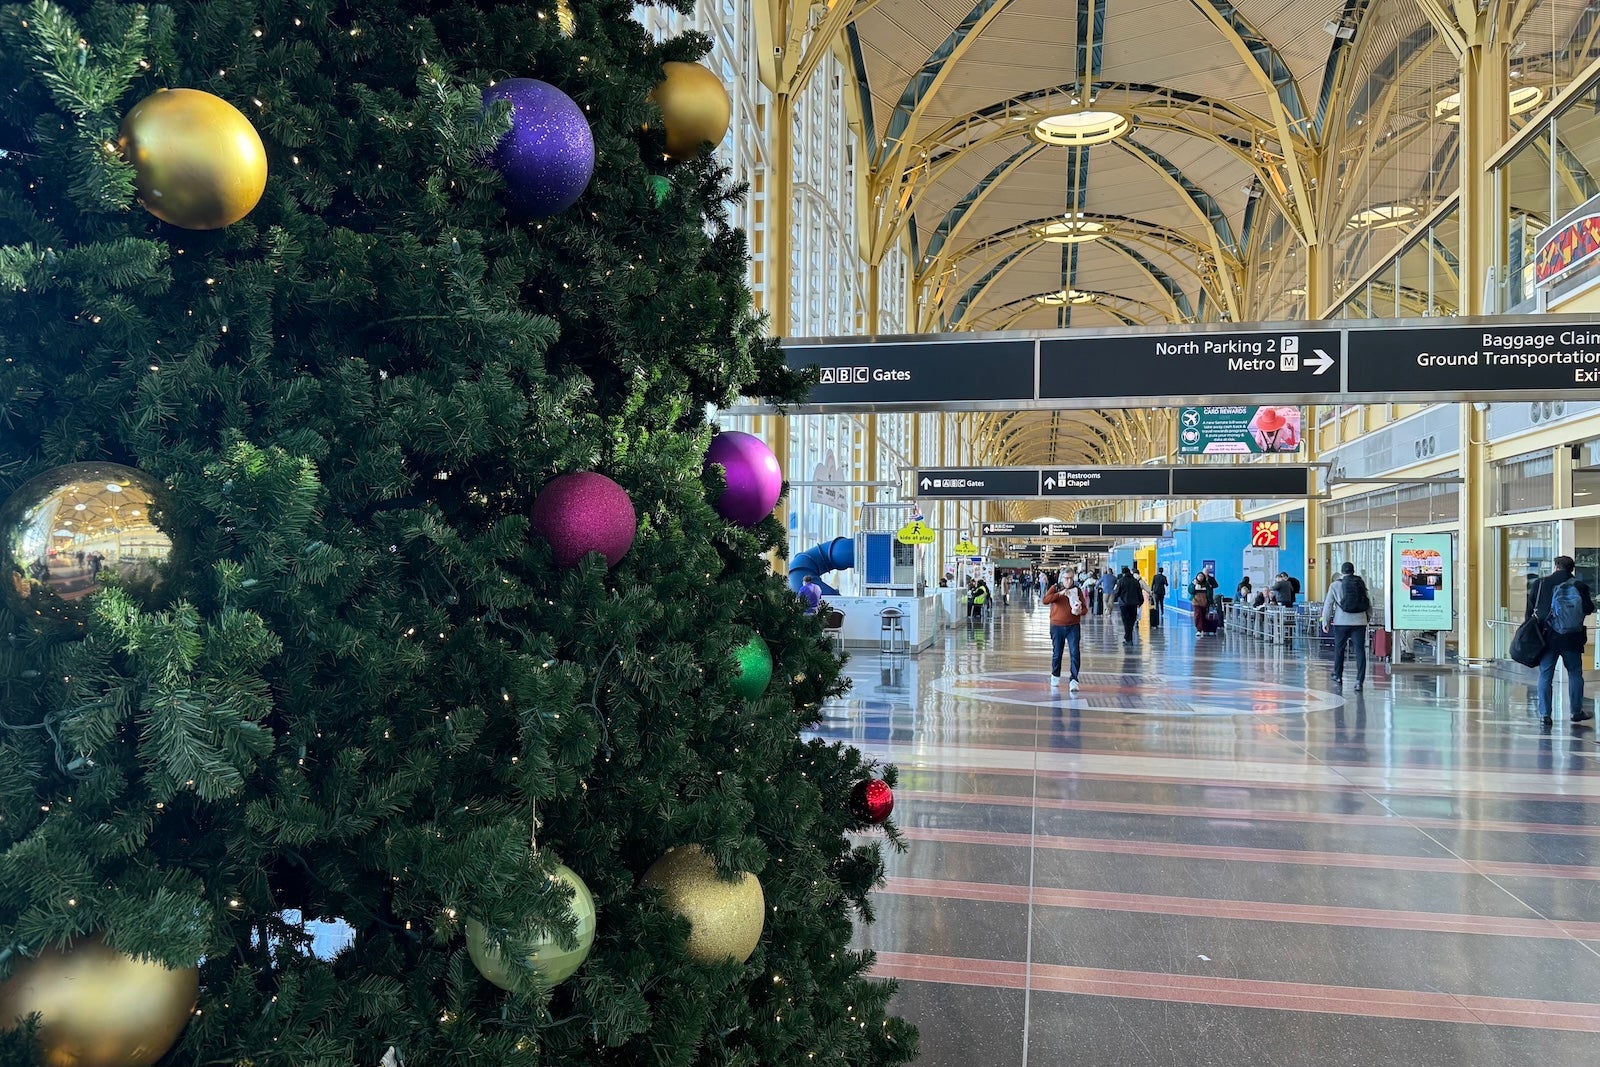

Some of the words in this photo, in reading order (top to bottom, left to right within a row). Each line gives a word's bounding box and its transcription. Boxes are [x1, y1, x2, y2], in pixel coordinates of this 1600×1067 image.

[1156, 340, 1200, 355] North
[1204, 340, 1262, 355] Parking
[1266, 339, 1276, 352] 2
[1284, 338, 1294, 350] P
[1482, 333, 1555, 350] Baggage
[1560, 330, 1600, 345] Claim
[1228, 358, 1276, 370] Metro
[1284, 357, 1294, 366] M
[1417, 351, 1478, 366] Ground
[873, 368, 911, 381] Gates
[1575, 368, 1600, 382] Exi
